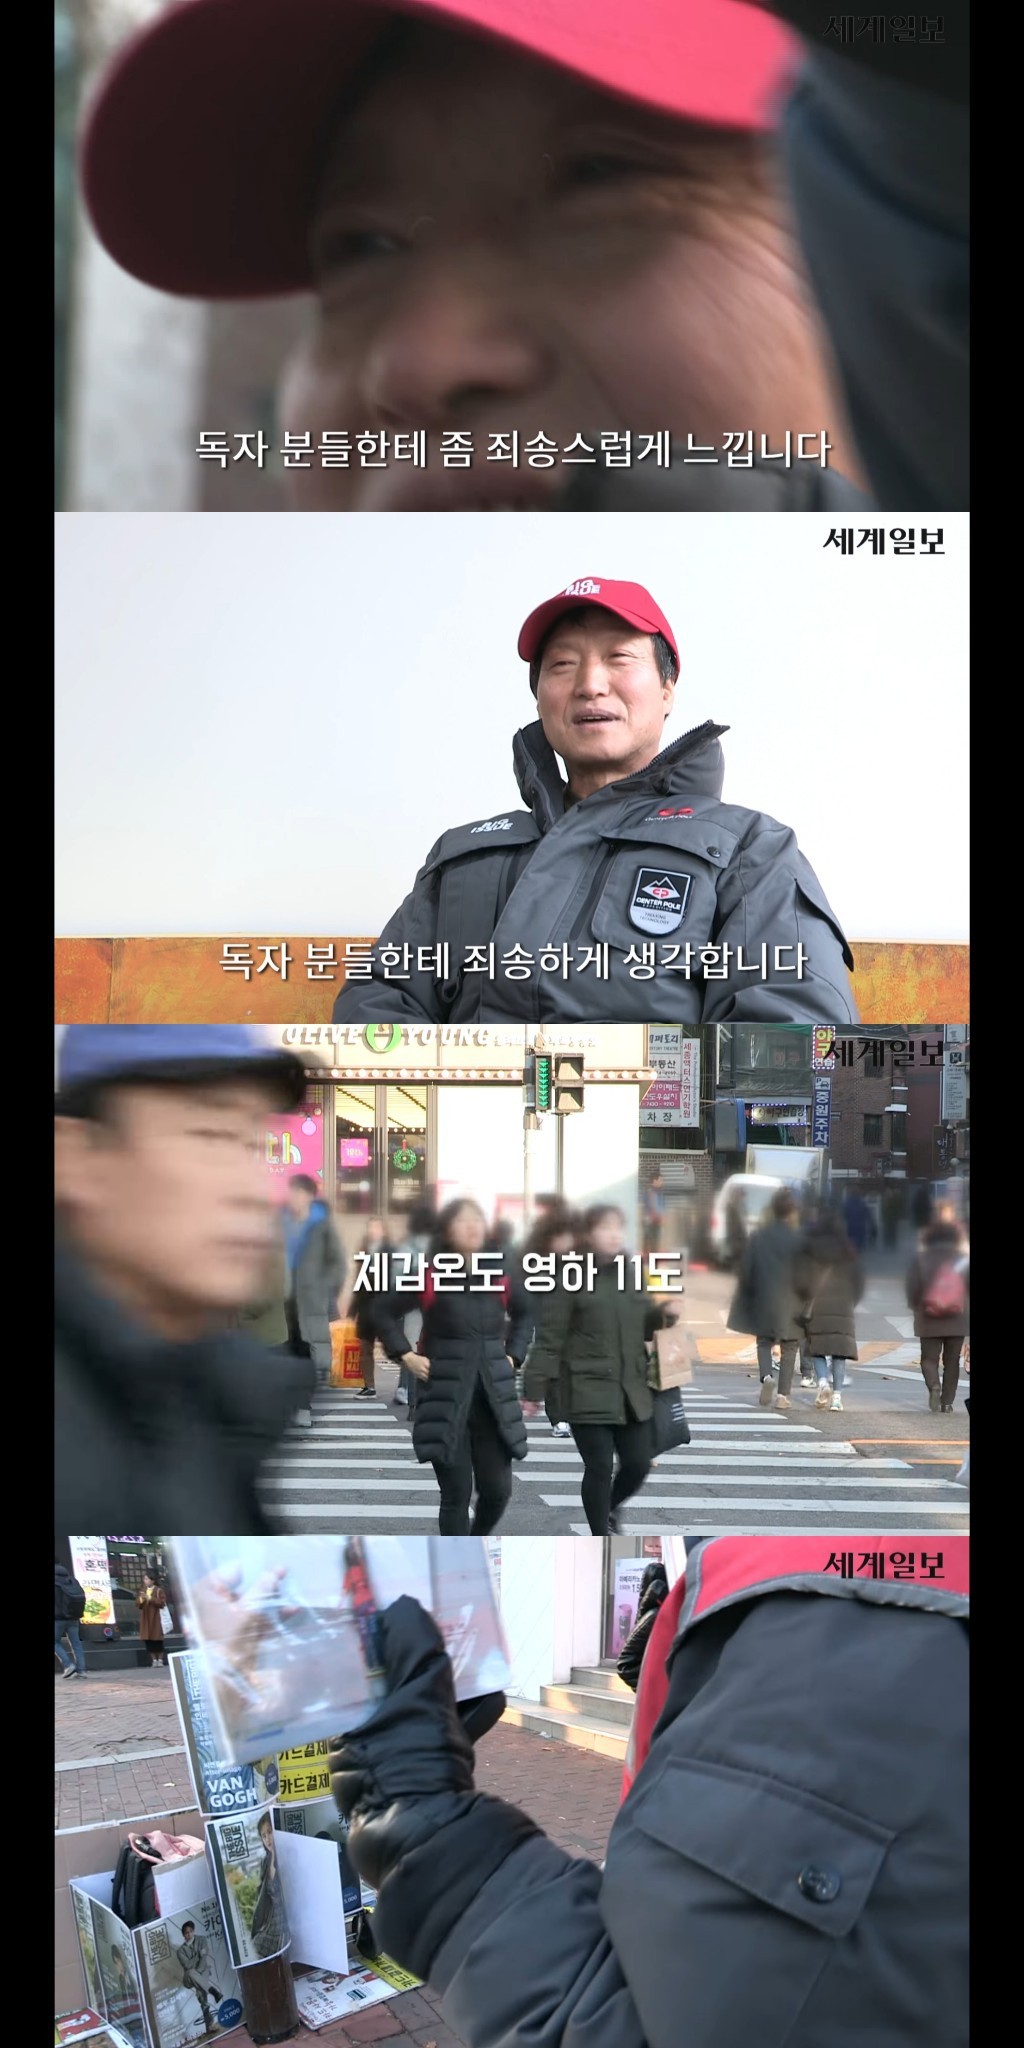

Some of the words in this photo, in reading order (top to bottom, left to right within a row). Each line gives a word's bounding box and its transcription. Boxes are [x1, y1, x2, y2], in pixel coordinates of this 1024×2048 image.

[635, 896, 663, 906] CENTER
[663, 900, 682, 911] POLE
[283, 1026, 360, 1046] OLIVE
[402, 1026, 489, 1047] YOUNG
[816, 1028, 833, 1057] 야구
[815, 1090, 829, 1147] 중원주차
[207, 1775, 243, 1793] VAN
[280, 1771, 330, 1795] 카드결제
[209, 1787, 257, 1808] GOGH
[222, 1827, 233, 1843] BIG
[232, 1824, 246, 1858] ISSUE
[227, 1843, 236, 1860] THE
[156, 1927, 169, 1960] ISSUE
